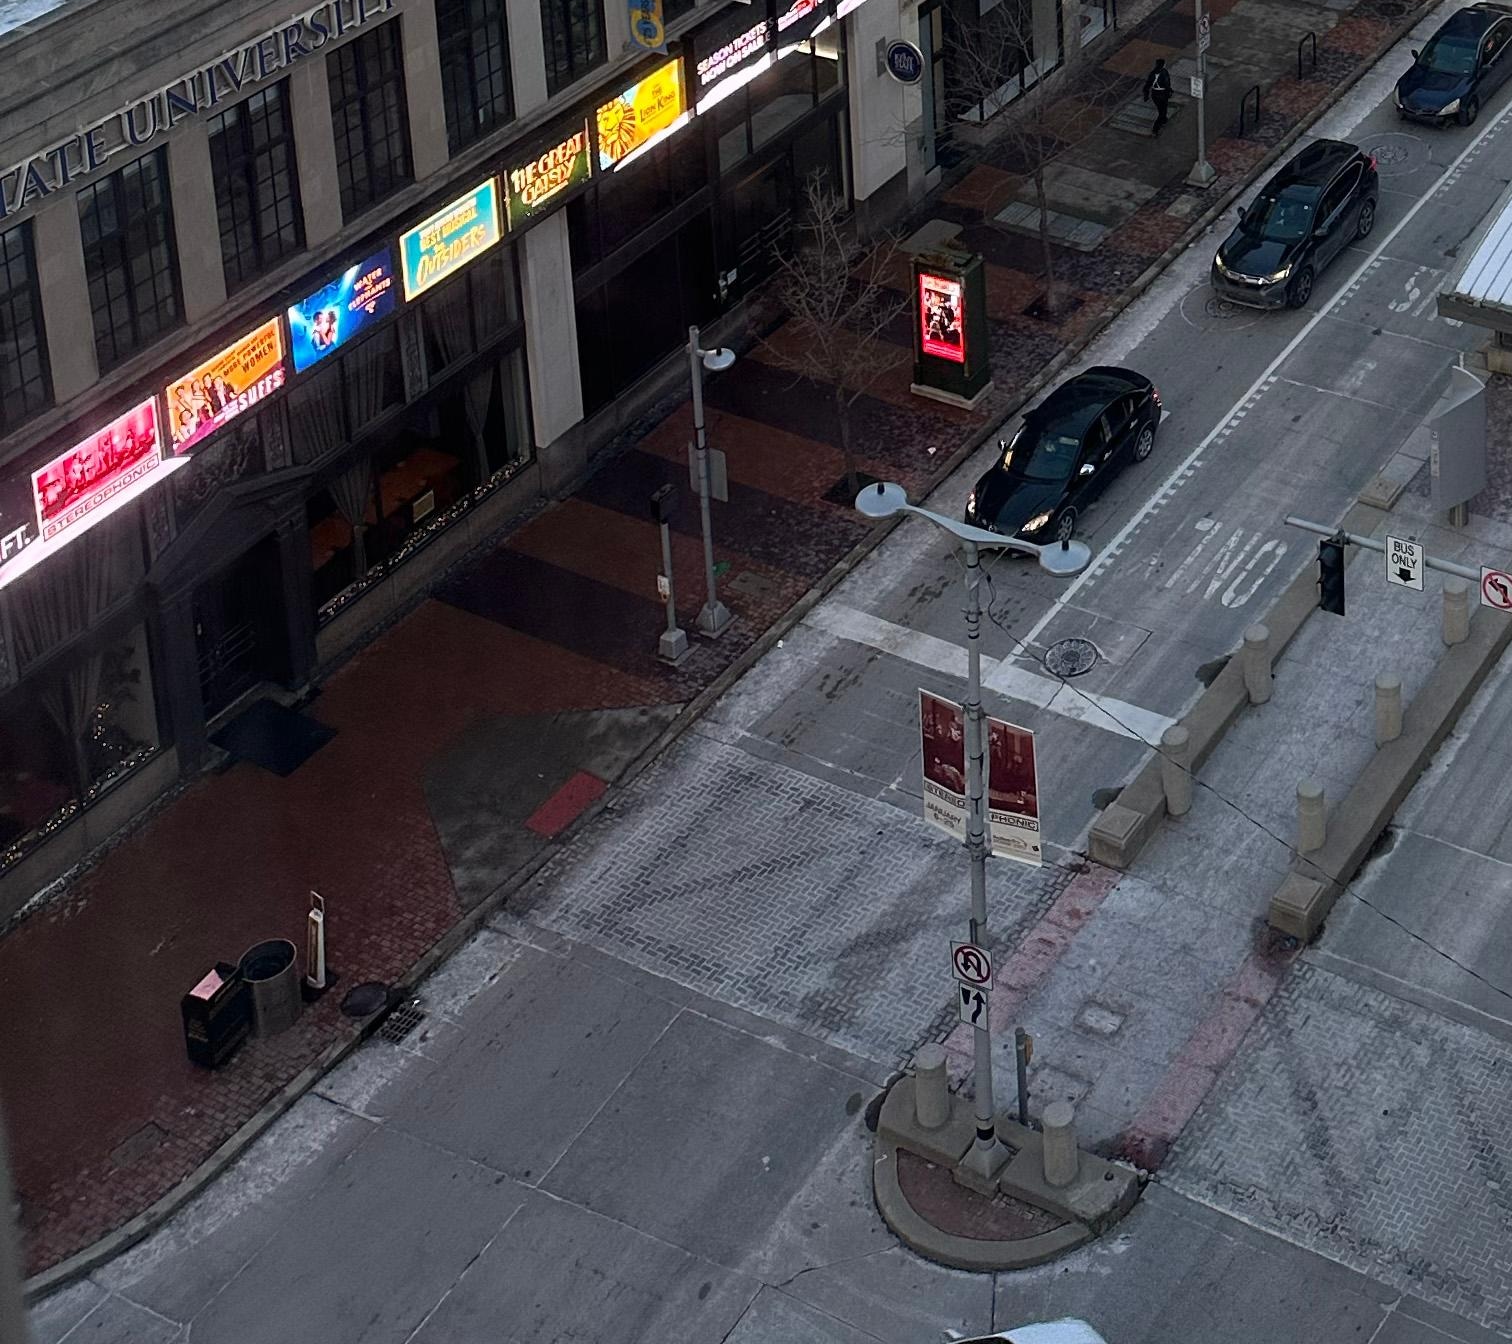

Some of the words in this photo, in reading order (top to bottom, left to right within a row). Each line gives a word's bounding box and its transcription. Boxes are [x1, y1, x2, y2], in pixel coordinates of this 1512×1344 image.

[697, 43, 734, 76] SEASON
[733, 20, 768, 49] TICKETS
[701, 60, 727, 86] NOW
[727, 51, 742, 68] ON
[537, 131, 586, 175] GREAT
[521, 154, 576, 205] GATSBY
[241, 342, 274, 373] WOMEN
[236, 367, 286, 412] SUFFS
[46, 457, 157, 536] STEREOPHONIC
[1391, 553, 1418, 569] ONLY
[1393, 541, 1415, 557] BUS
[925, 781, 967, 809] STEREO
[990, 813, 1037, 829] PHONIC
